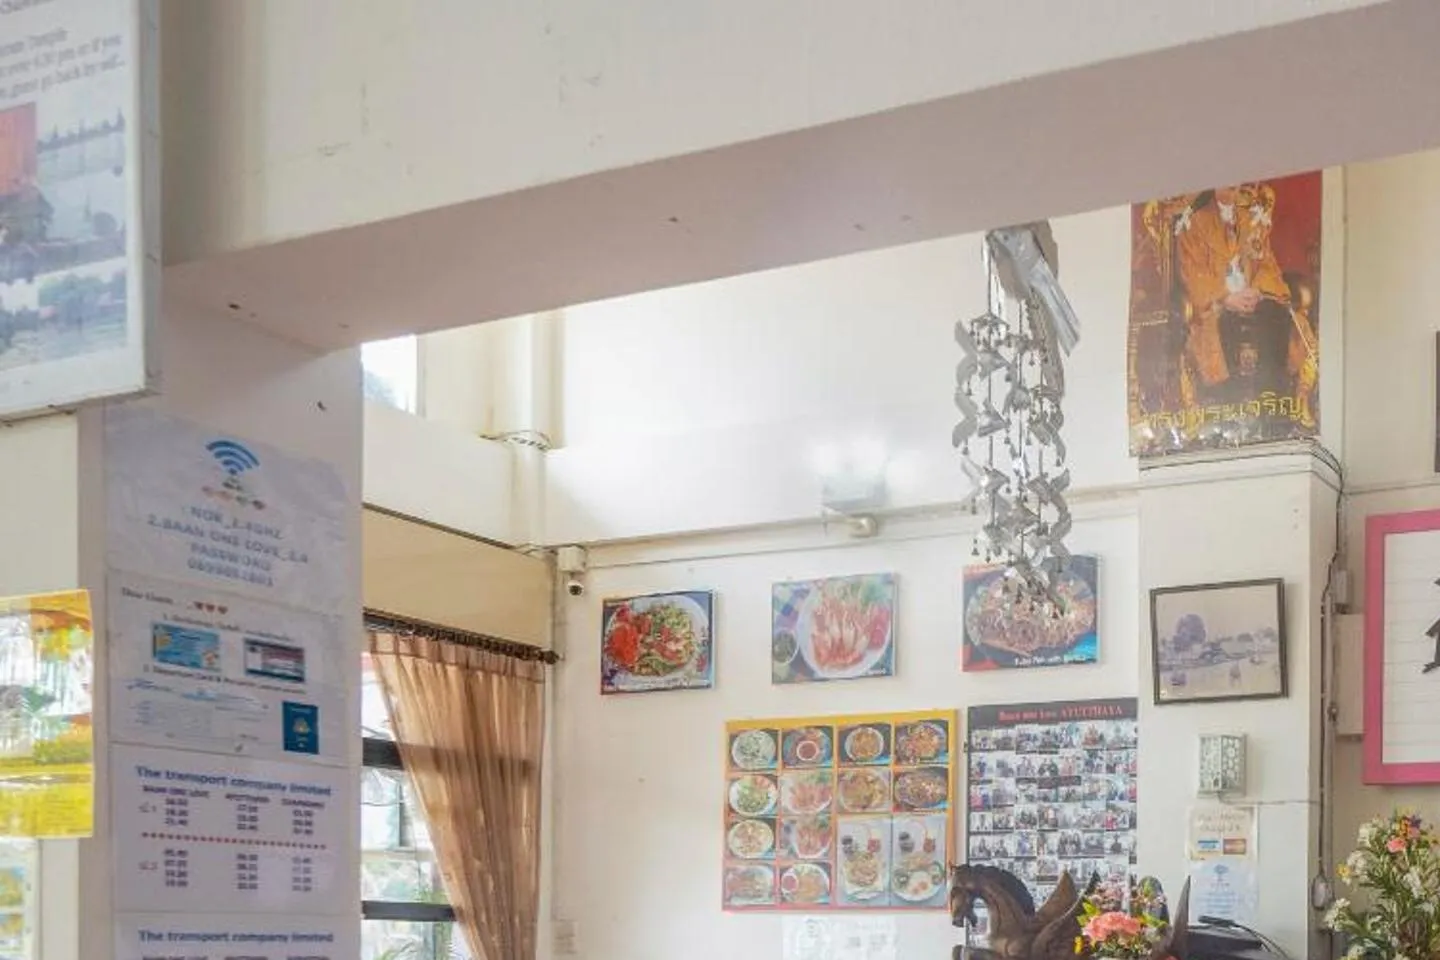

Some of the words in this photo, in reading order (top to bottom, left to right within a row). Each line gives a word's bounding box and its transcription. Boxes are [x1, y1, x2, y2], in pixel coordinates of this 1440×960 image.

[135, 766, 161, 778] The
[165, 770, 228, 787] transport
[230, 778, 287, 793] company
[289, 783, 331, 797] limited
[138, 930, 163, 942] The
[167, 931, 230, 943] transport
[232, 931, 289, 944] company
[291, 931, 334, 943] limited
